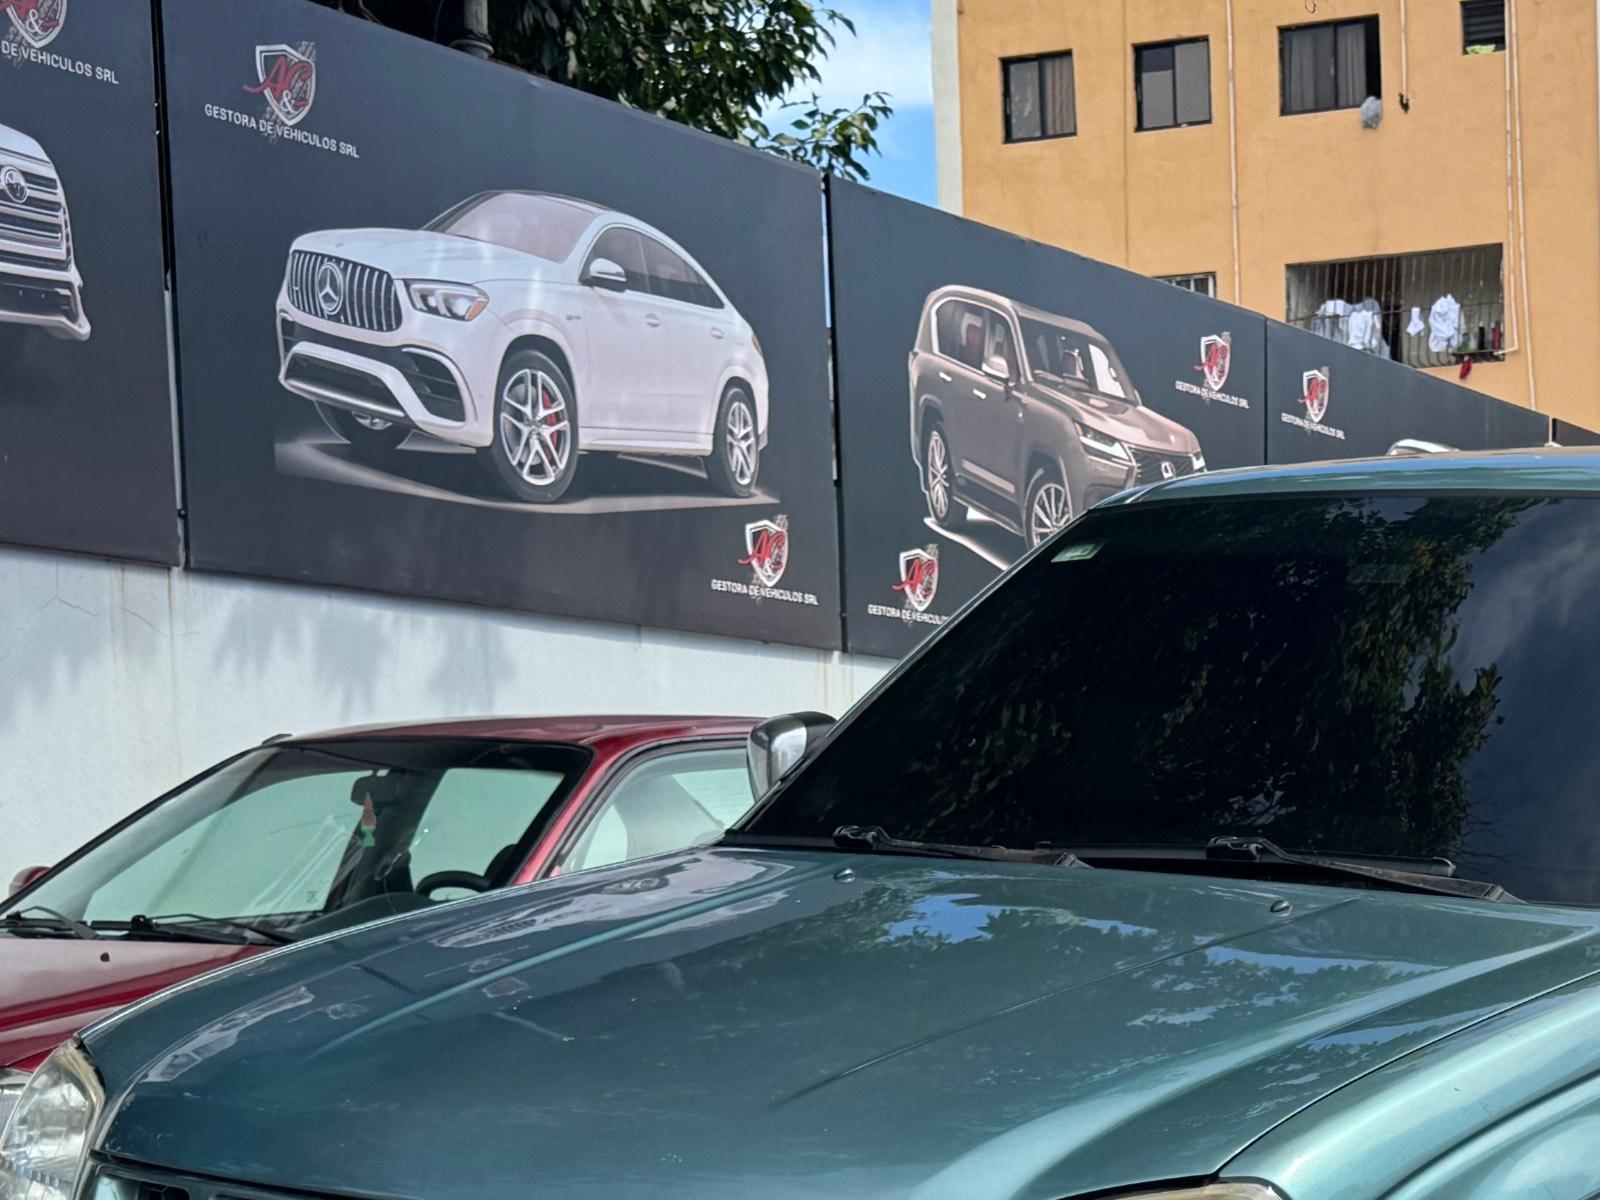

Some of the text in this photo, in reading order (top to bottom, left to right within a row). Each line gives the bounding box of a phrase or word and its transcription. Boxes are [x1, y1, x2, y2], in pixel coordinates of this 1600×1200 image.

[21, 46, 92, 77] VEHICULOS
[95, 66, 119, 84] SRL
[204, 104, 360, 158] GESTORA DE VEHICULOS SRL
